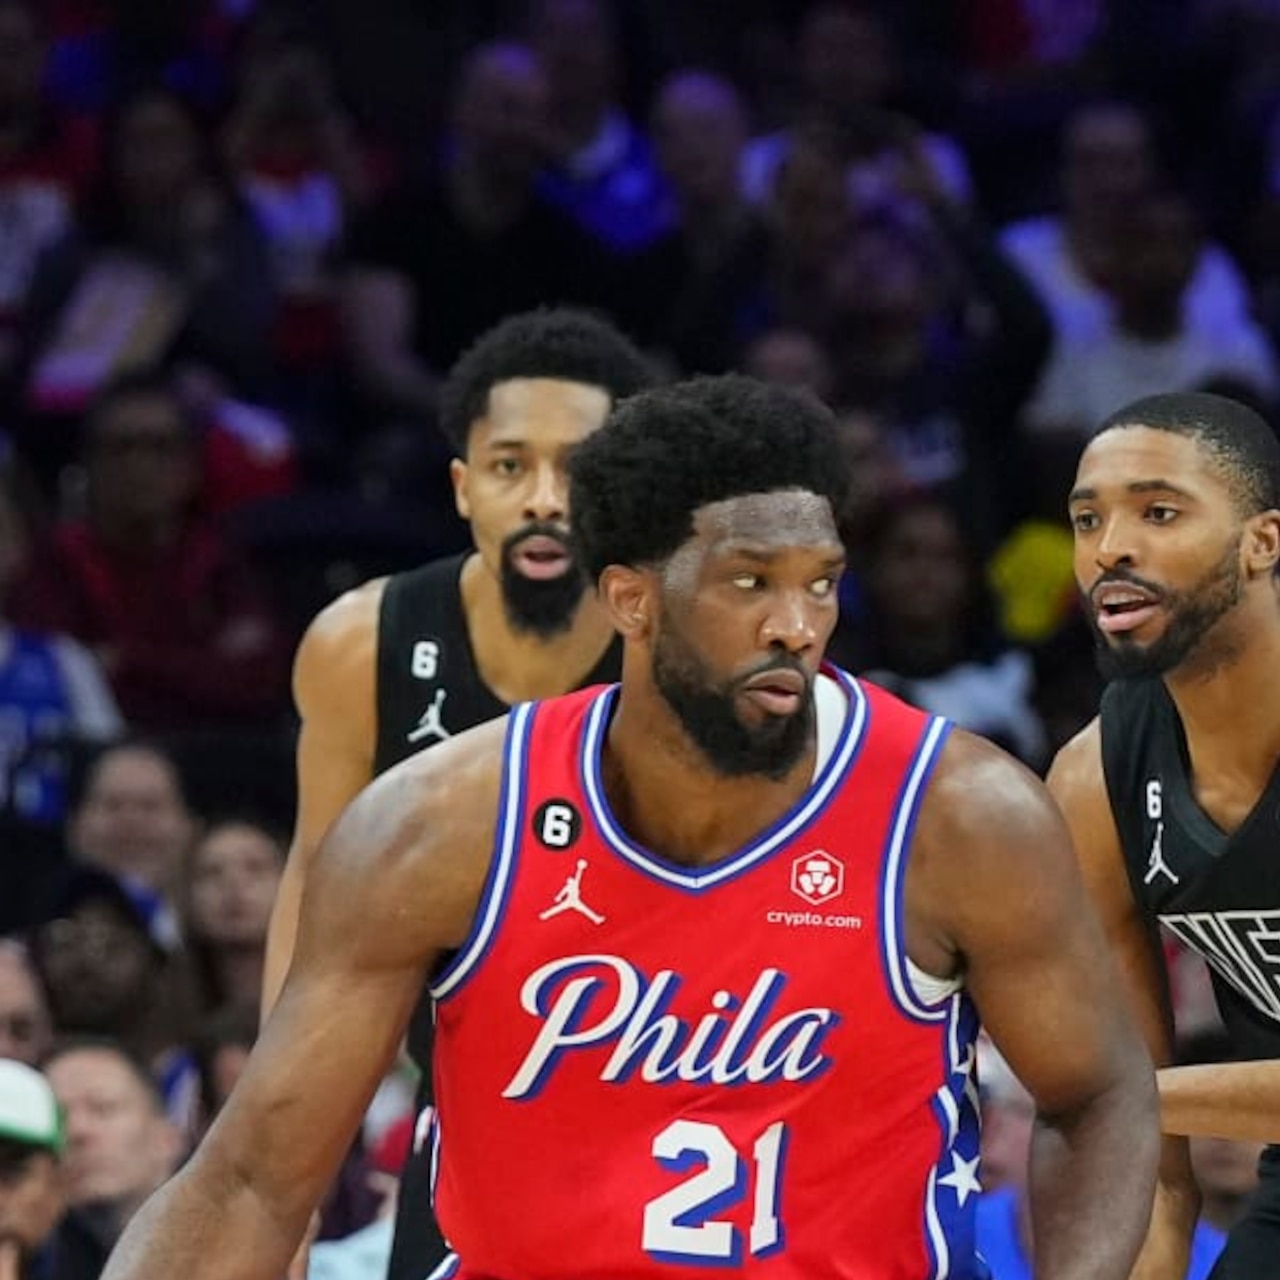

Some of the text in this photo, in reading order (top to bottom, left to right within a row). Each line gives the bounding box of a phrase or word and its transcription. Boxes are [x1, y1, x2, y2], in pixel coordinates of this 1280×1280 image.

[411, 640, 439, 679] 6
[1145, 780, 1163, 819] 6
[542, 805, 572, 846] 6
[766, 911, 862, 929] crypto.com
[501, 954, 844, 1104] Phila
[641, 1119, 791, 1268] 21
